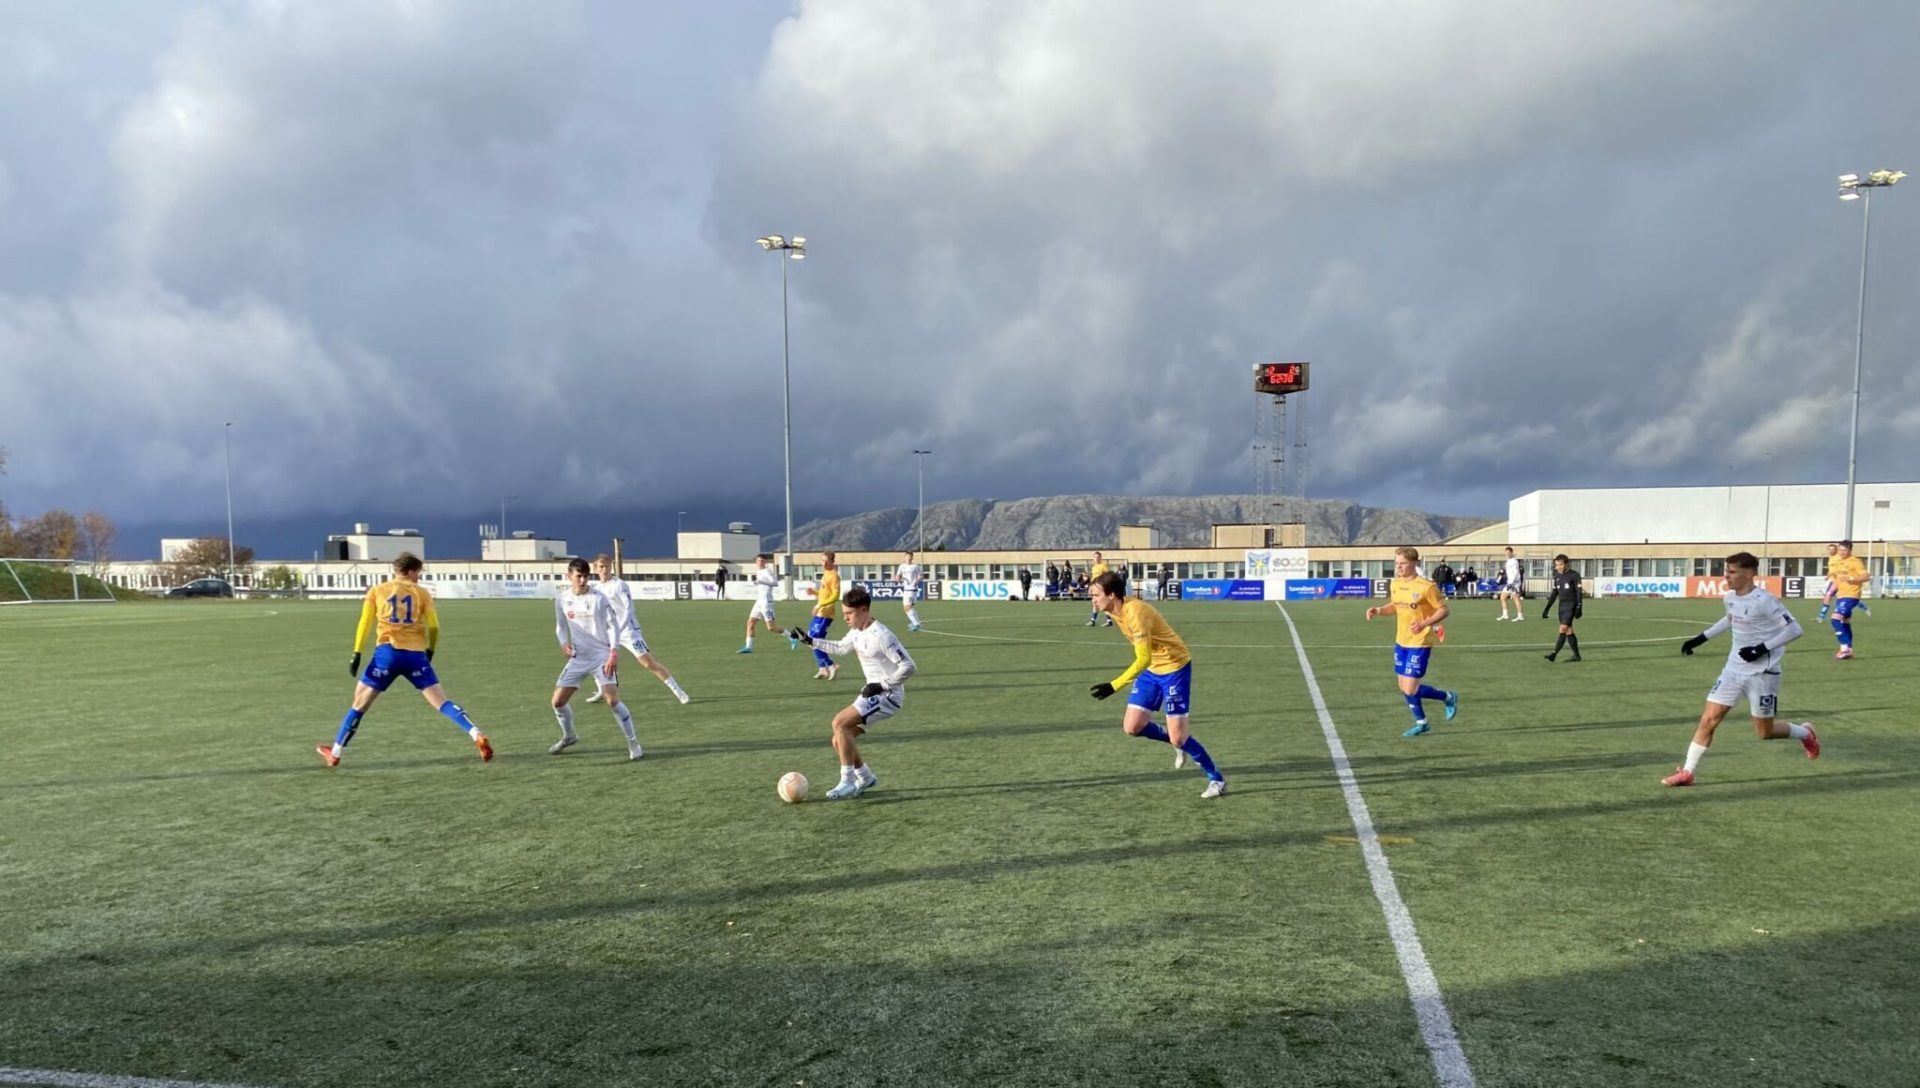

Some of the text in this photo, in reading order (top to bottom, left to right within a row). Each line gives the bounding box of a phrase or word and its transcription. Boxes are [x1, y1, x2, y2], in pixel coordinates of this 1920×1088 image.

[872, 588, 922, 598] KRAT
[950, 582, 1009, 598] SINUS
[1616, 582, 1680, 592] POLYGON
[386, 594, 414, 624] 11
